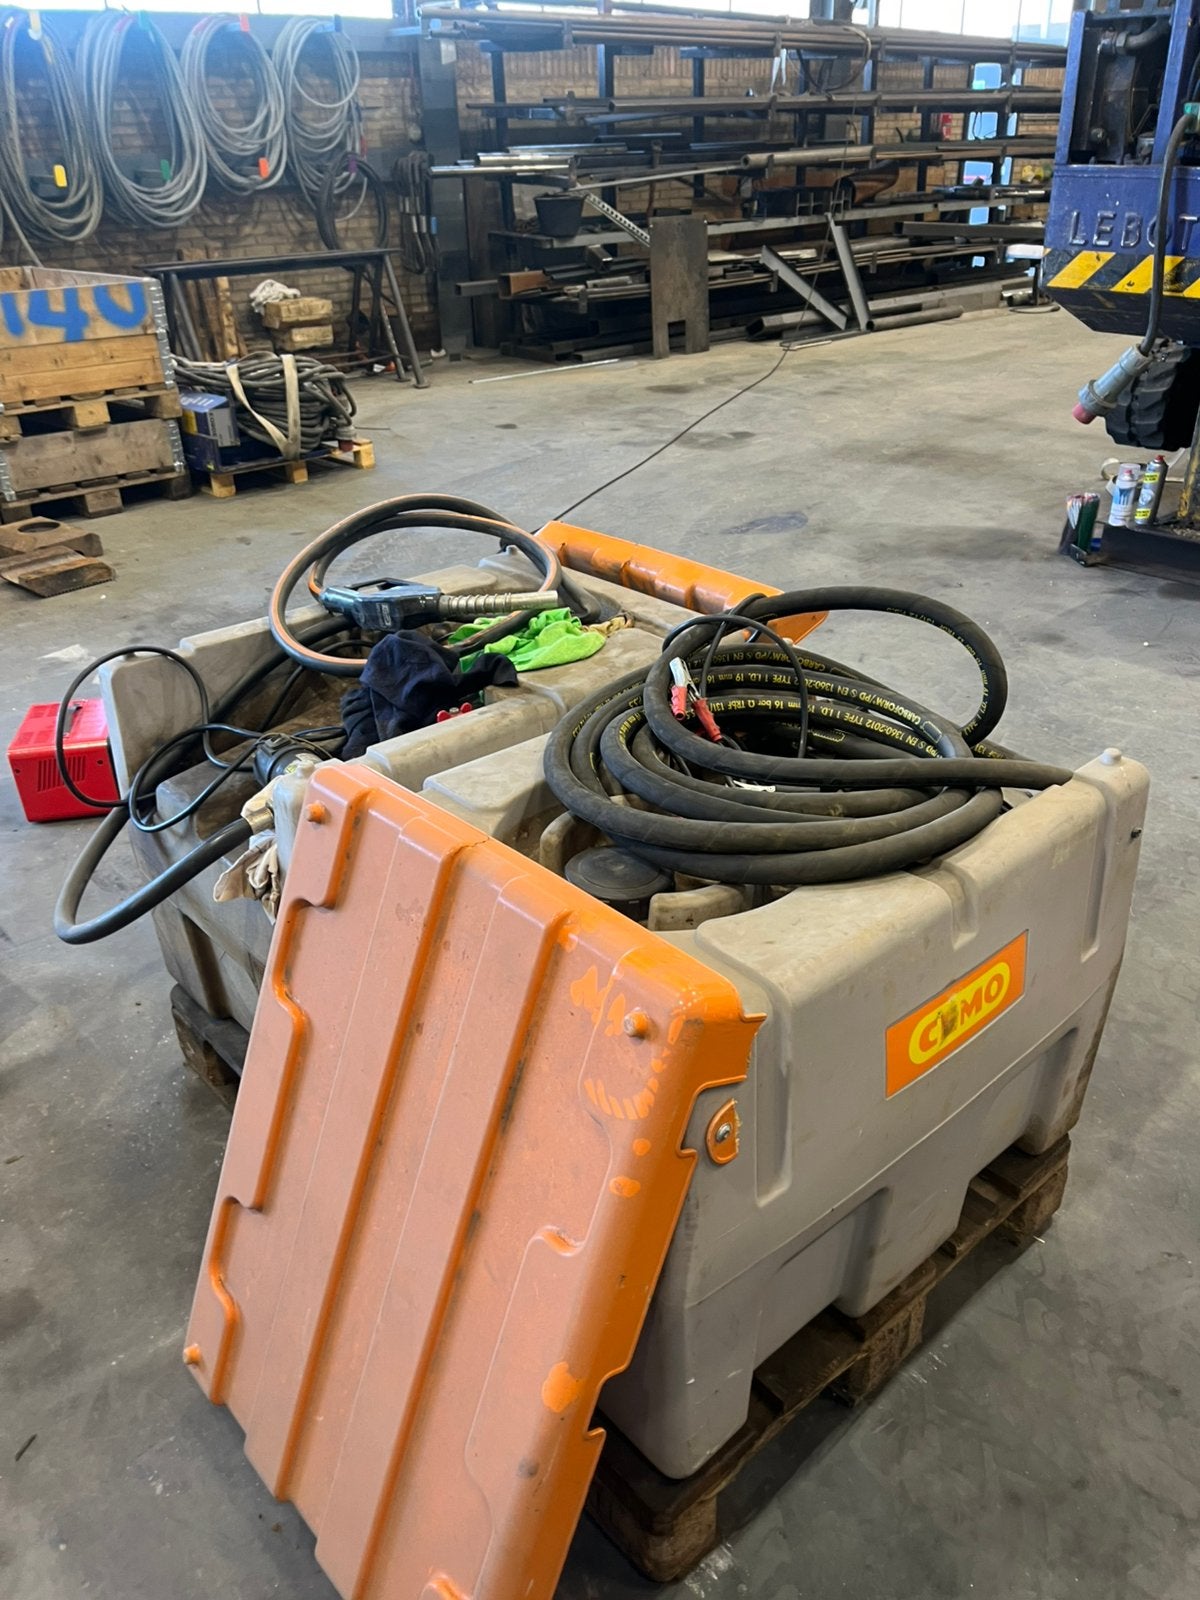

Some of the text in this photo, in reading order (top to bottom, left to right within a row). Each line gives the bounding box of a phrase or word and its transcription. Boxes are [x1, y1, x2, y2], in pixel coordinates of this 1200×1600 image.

[706, 674, 715, 684] 16
[735, 672, 744, 682] 19
[748, 672, 762, 681] I.D.
[765, 674, 769, 682] 1
[772, 674, 792, 685] TYPE
[793, 676, 835, 692] 1360:202
[837, 685, 849, 696] EN
[727, 699, 746, 710] TRbF
[758, 699, 772, 710] bar
[774, 699, 784, 710] 16
[820, 705, 834, 717] I.D.
[836, 710, 841, 719] 1
[843, 712, 864, 726] TYPE
[865, 719, 905, 741] 1360:2012
[905, 734, 919, 747] EN
